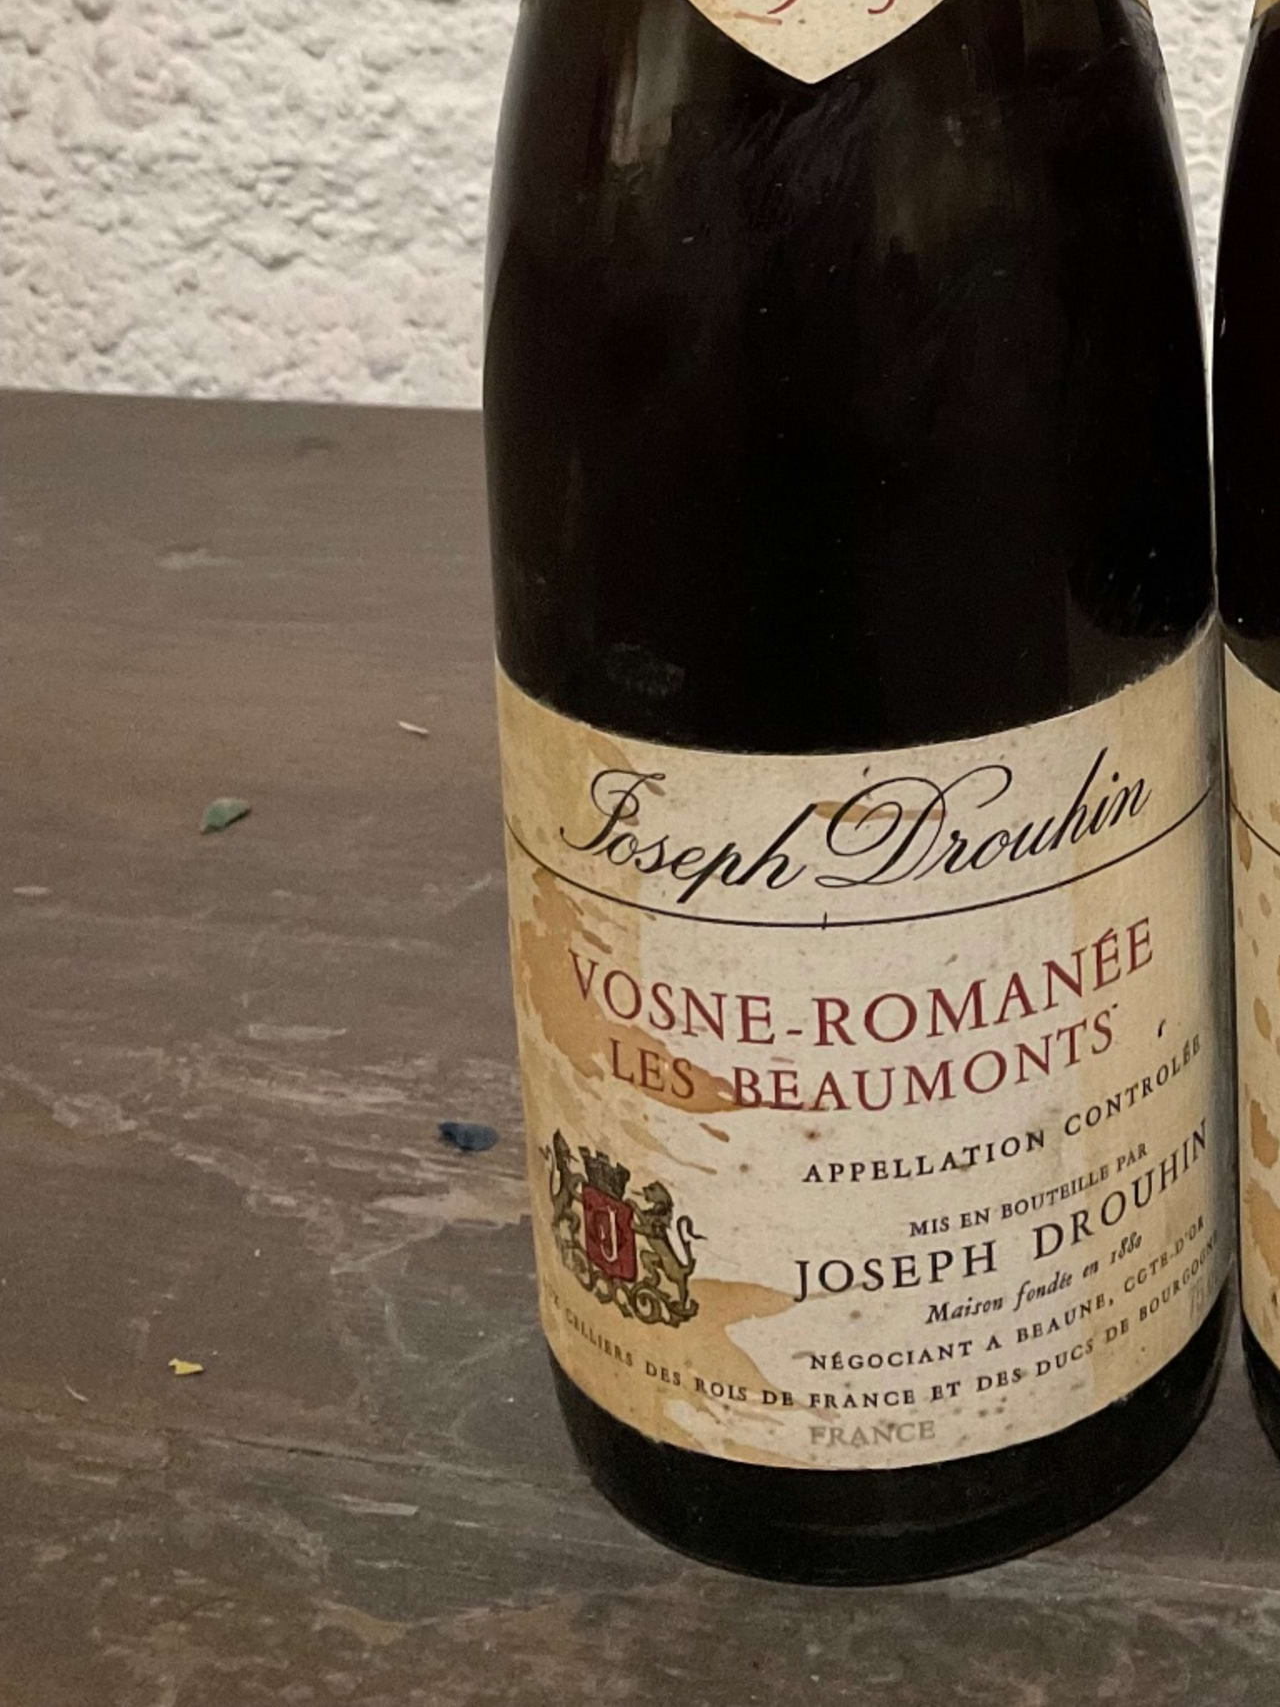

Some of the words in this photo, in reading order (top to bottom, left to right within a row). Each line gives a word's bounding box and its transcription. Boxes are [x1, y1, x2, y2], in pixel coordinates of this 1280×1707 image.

[558, 768, 819, 904] Joseph
[814, 746, 1153, 890] Drouhin
[567, 916, 1154, 1047] VOSNE-ROMANÉE
[608, 1037, 695, 1101] LES
[733, 1008, 1113, 1112] BEAUMONTS
[802, 1129, 1045, 1183] APPELLATION
[909, 1217, 949, 1237] MIS
[960, 1207, 990, 1229] EN
[1001, 1165, 1109, 1220] BOUTEILLE
[1116, 1143, 1148, 1173] PAR
[793, 1239, 998, 1303] JOSEPH
[1032, 1118, 1206, 1261] DROUHIN
[925, 1296, 1004, 1325] Maison
[1083, 1259, 1100, 1279] en
[1110, 1230, 1143, 1266] 1880
[645, 1360, 682, 1387] DES
[695, 1377, 747, 1402] ROIS
[762, 1390, 794, 1407] DE
[809, 1390, 916, 1410] FRANCE
[931, 1380, 961, 1403] ET
[976, 1367, 1022, 1393] DES
[1035, 1338, 1095, 1378] DUCS
[1105, 1318, 1131, 1345] DE
[810, 1340, 973, 1371] NÉGOCIANT
[986, 1335, 1003, 1352] A
[1016, 1292, 1115, 1344] BEAUNE,
[807, 1420, 936, 1446] FRANCE
